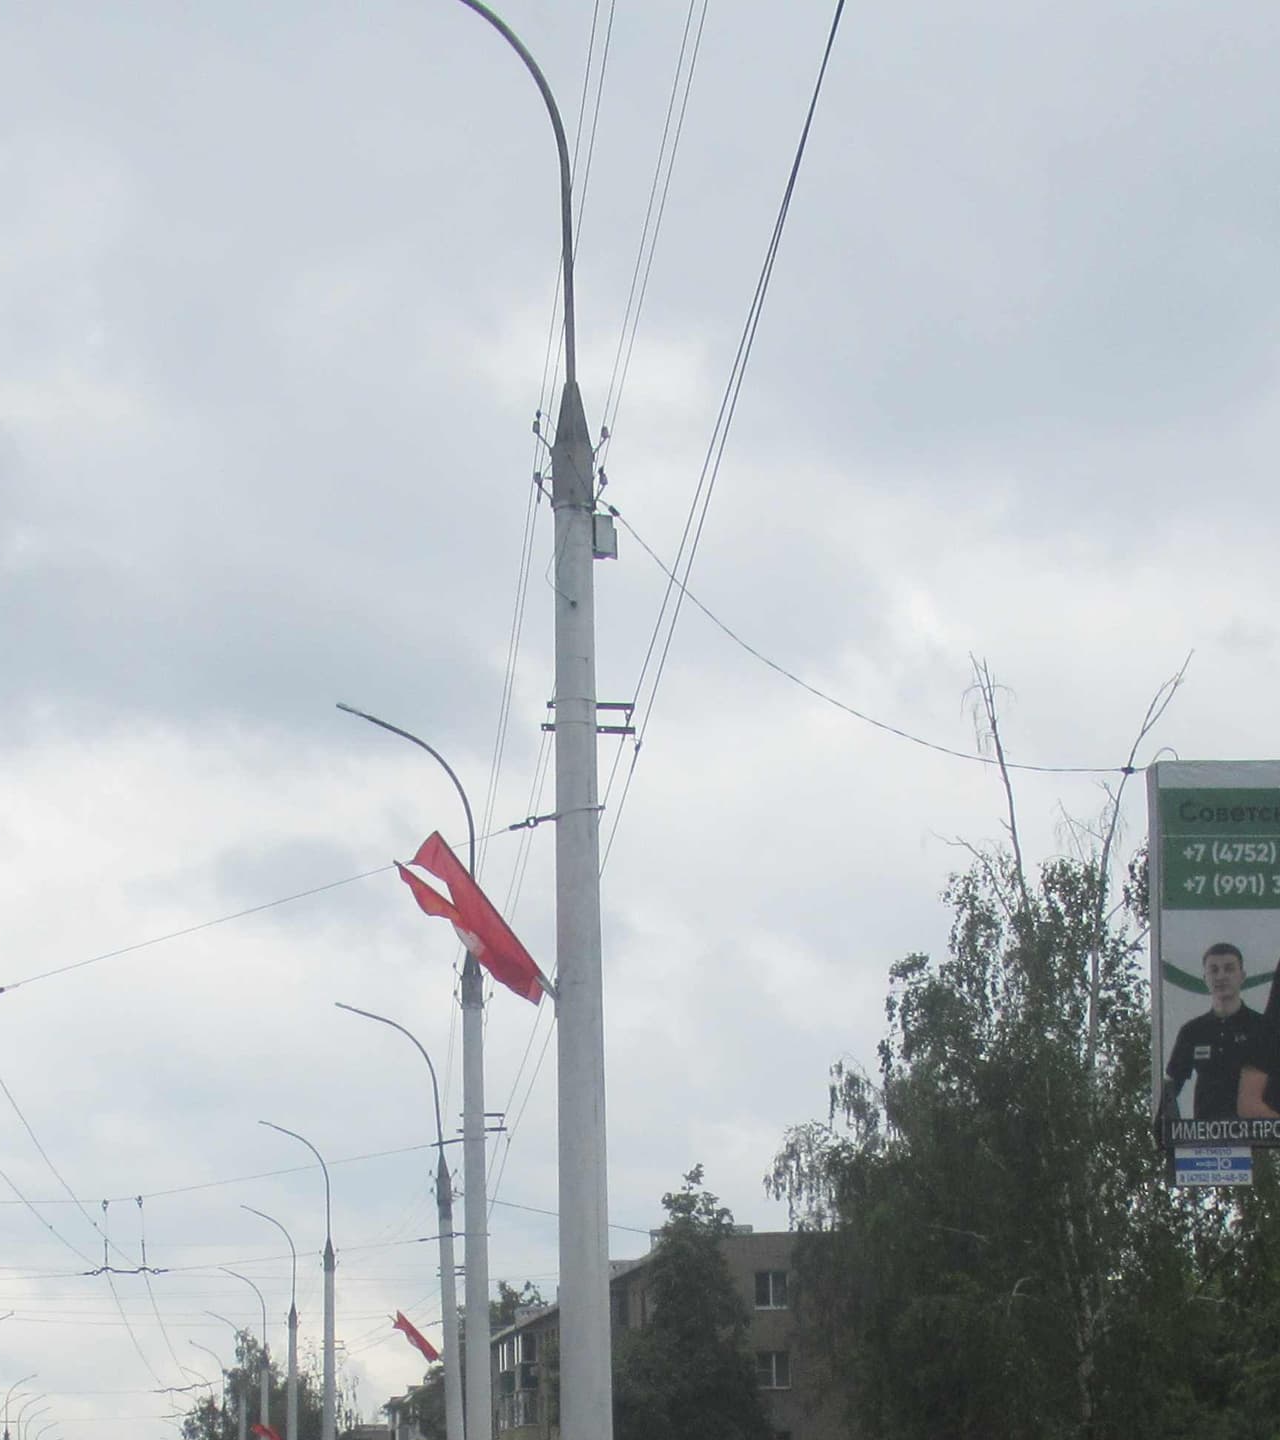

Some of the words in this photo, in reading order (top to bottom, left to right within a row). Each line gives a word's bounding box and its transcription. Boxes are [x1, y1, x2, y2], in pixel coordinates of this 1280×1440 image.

[1183, 844, 1206, 863] +7
[1211, 841, 1277, 865] (4752)
[1183, 876, 1207, 895] +7
[1213, 874, 1266, 897] (991)
[1172, 1120, 1249, 1140] ИМЕЮТСЯ
